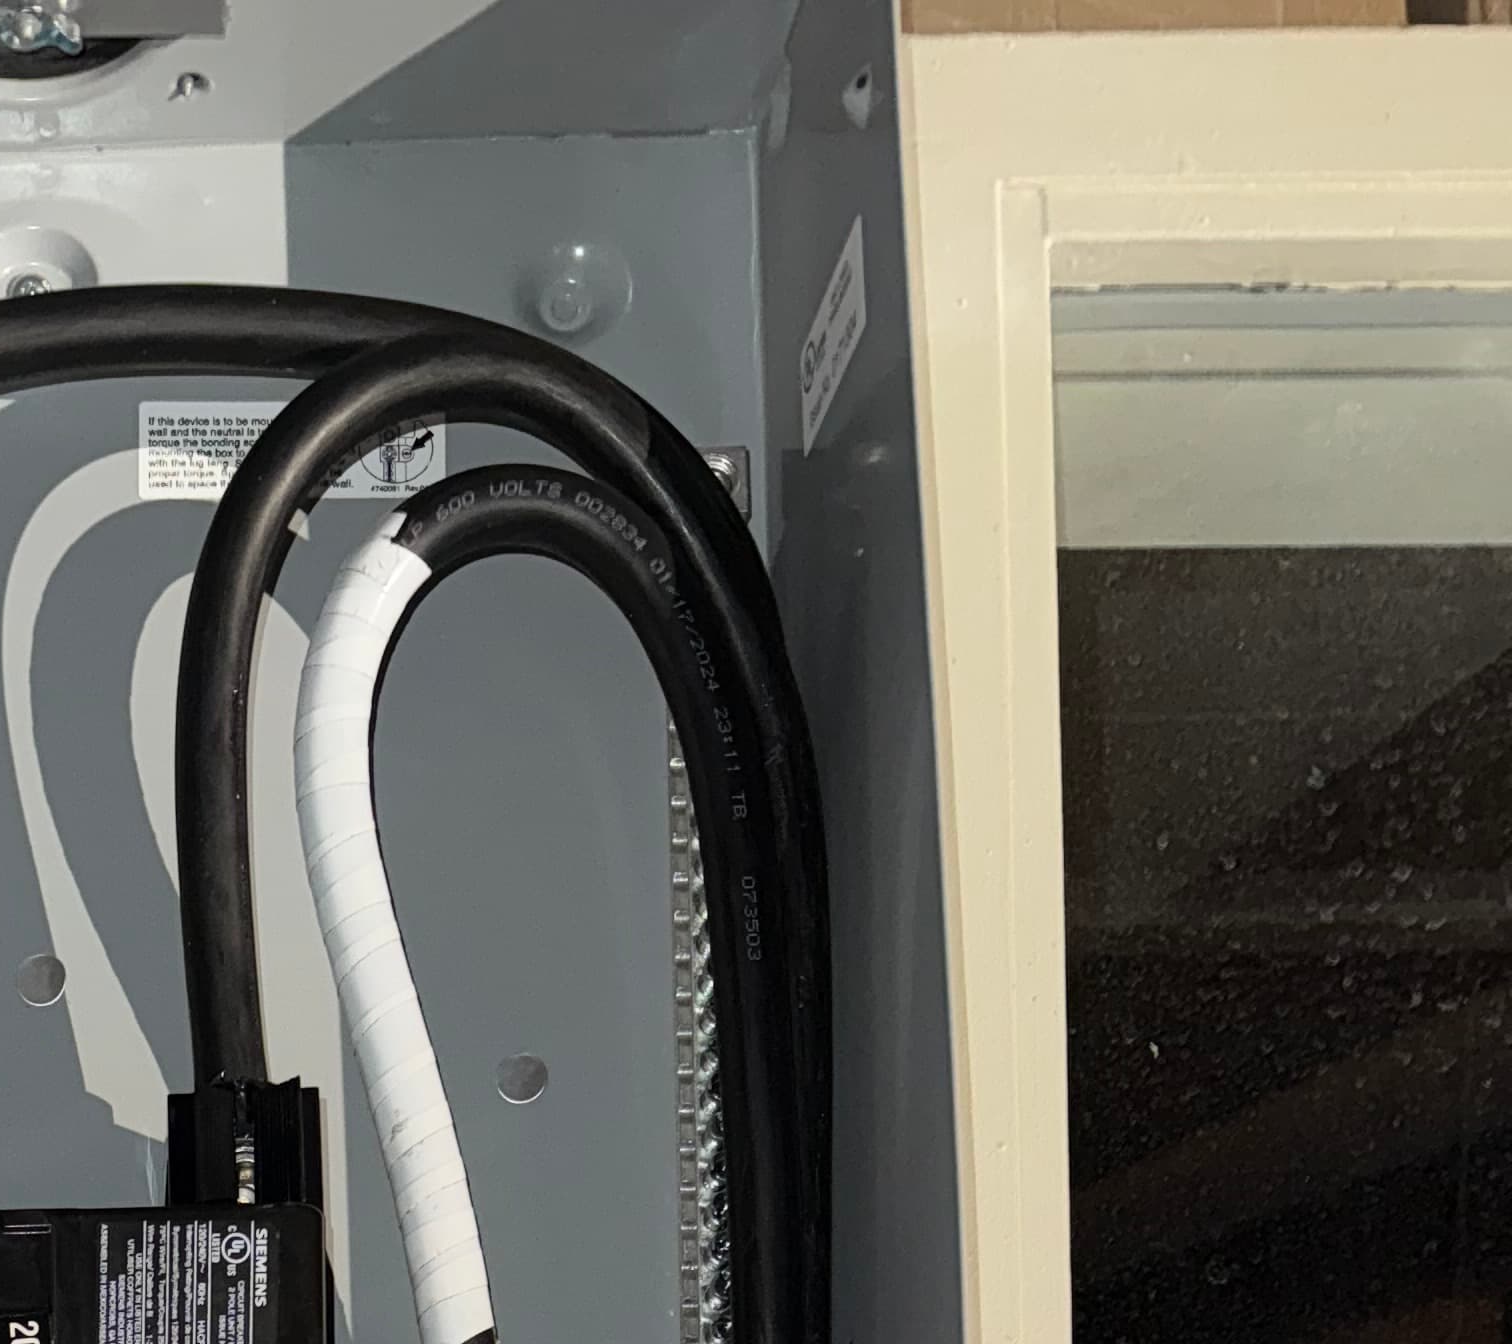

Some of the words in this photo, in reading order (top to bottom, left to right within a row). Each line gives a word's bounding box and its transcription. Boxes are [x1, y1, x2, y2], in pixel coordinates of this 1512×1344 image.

[148, 416, 155, 426] If
[157, 416, 175, 426] this
[178, 416, 210, 426] device
[213, 416, 220, 426] is
[224, 416, 233, 426] to
[236, 416, 248, 426] be
[251, 418, 274, 426] mou
[148, 428, 168, 436] wall
[171, 428, 189, 436] and
[192, 428, 208, 436] the
[210, 428, 244, 436] neutral
[247, 428, 255, 436] is
[148, 439, 180, 448] torque
[183, 438, 198, 447] the
[201, 438, 240, 448] bonding
[197, 448, 212, 458] the
[215, 448, 233, 458] box
[236, 449, 245, 458] to
[148, 459, 168, 468] with
[171, 459, 186, 468] the
[435, 490, 476, 522] 600
[488, 478, 564, 500] VOLTS
[574, 490, 648, 552] 002834
[730, 791, 748, 821] TB
[740, 874, 762, 962] 073503
[211, 1233, 220, 1263] LISTED
[226, 1264, 236, 1276] US
[255, 1228, 267, 1307] SIEMENS
[227, 1293, 235, 1315] POLE
